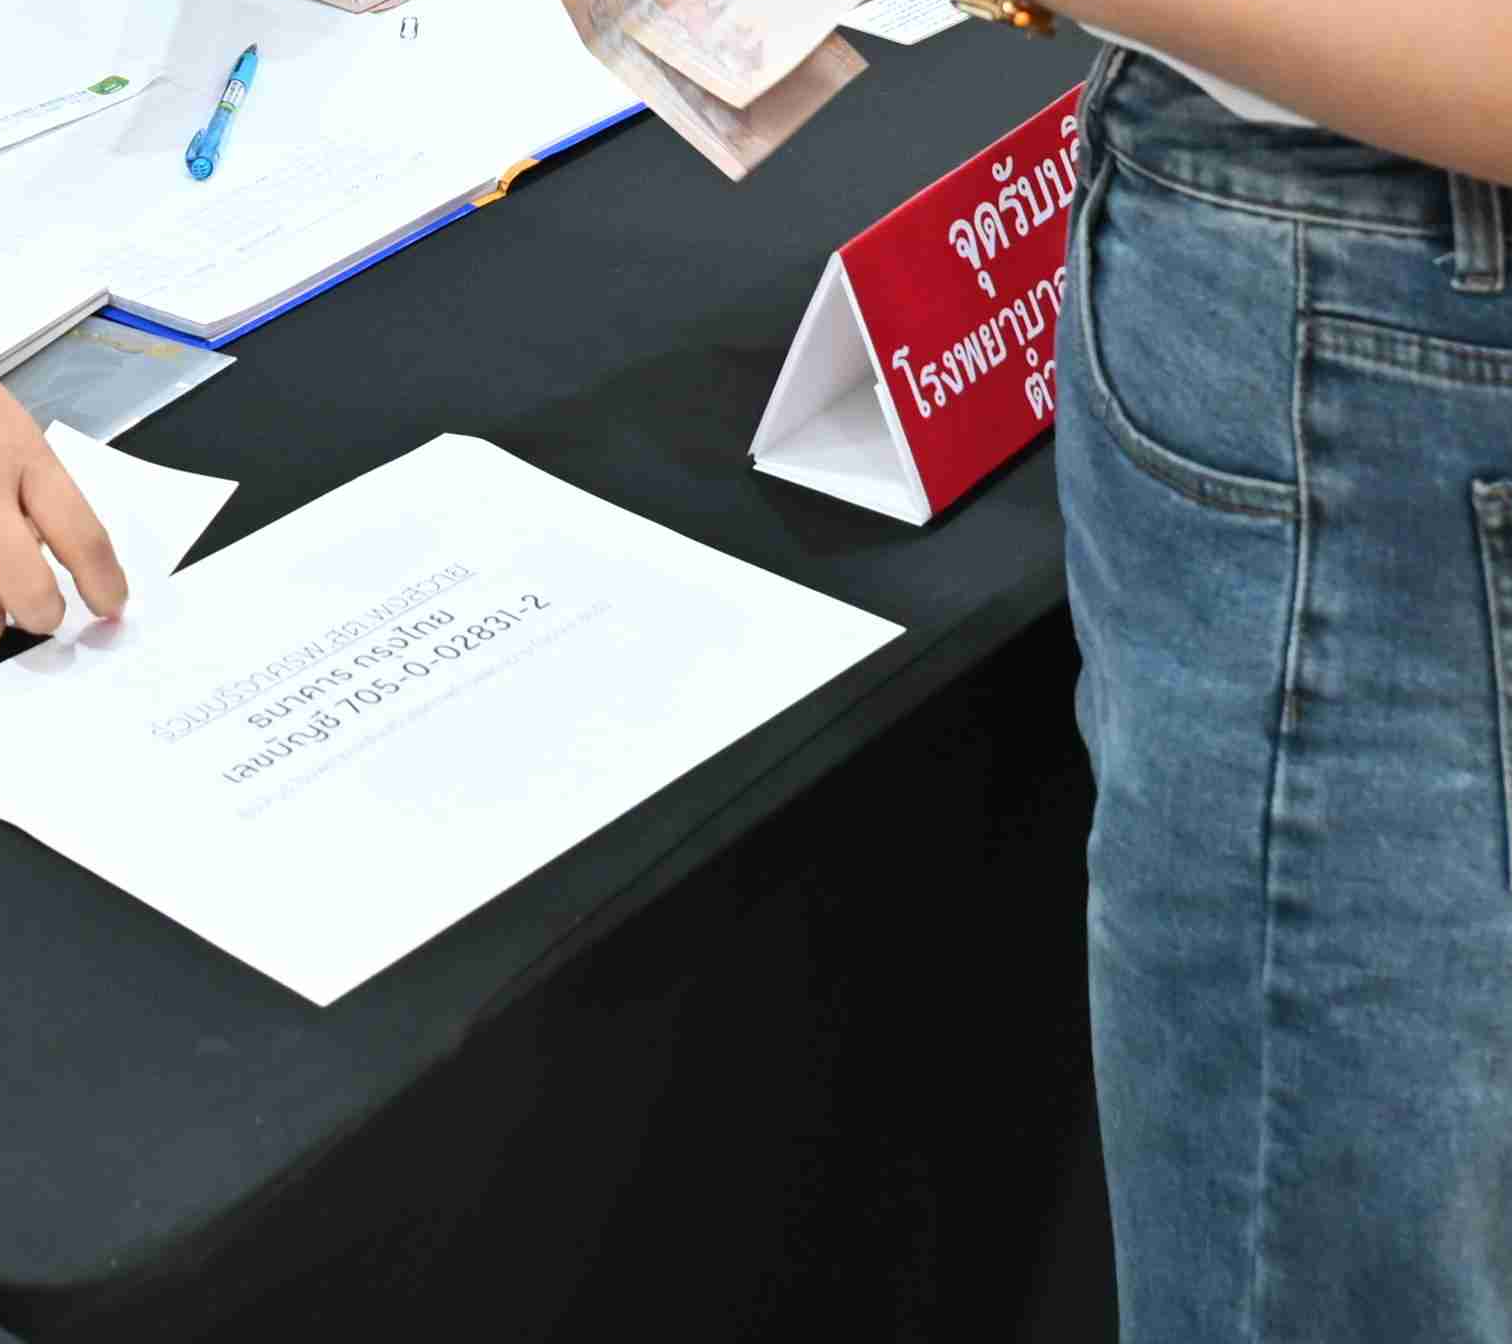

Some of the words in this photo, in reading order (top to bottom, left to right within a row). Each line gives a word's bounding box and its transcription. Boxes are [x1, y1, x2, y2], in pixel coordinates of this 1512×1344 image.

[221, 708, 342, 786] เลขบัญชี
[337, 592, 552, 717] 705-0-02831-2
[247, 664, 353, 730] ธนาคาร
[353, 606, 457, 671] กรุงไทย
